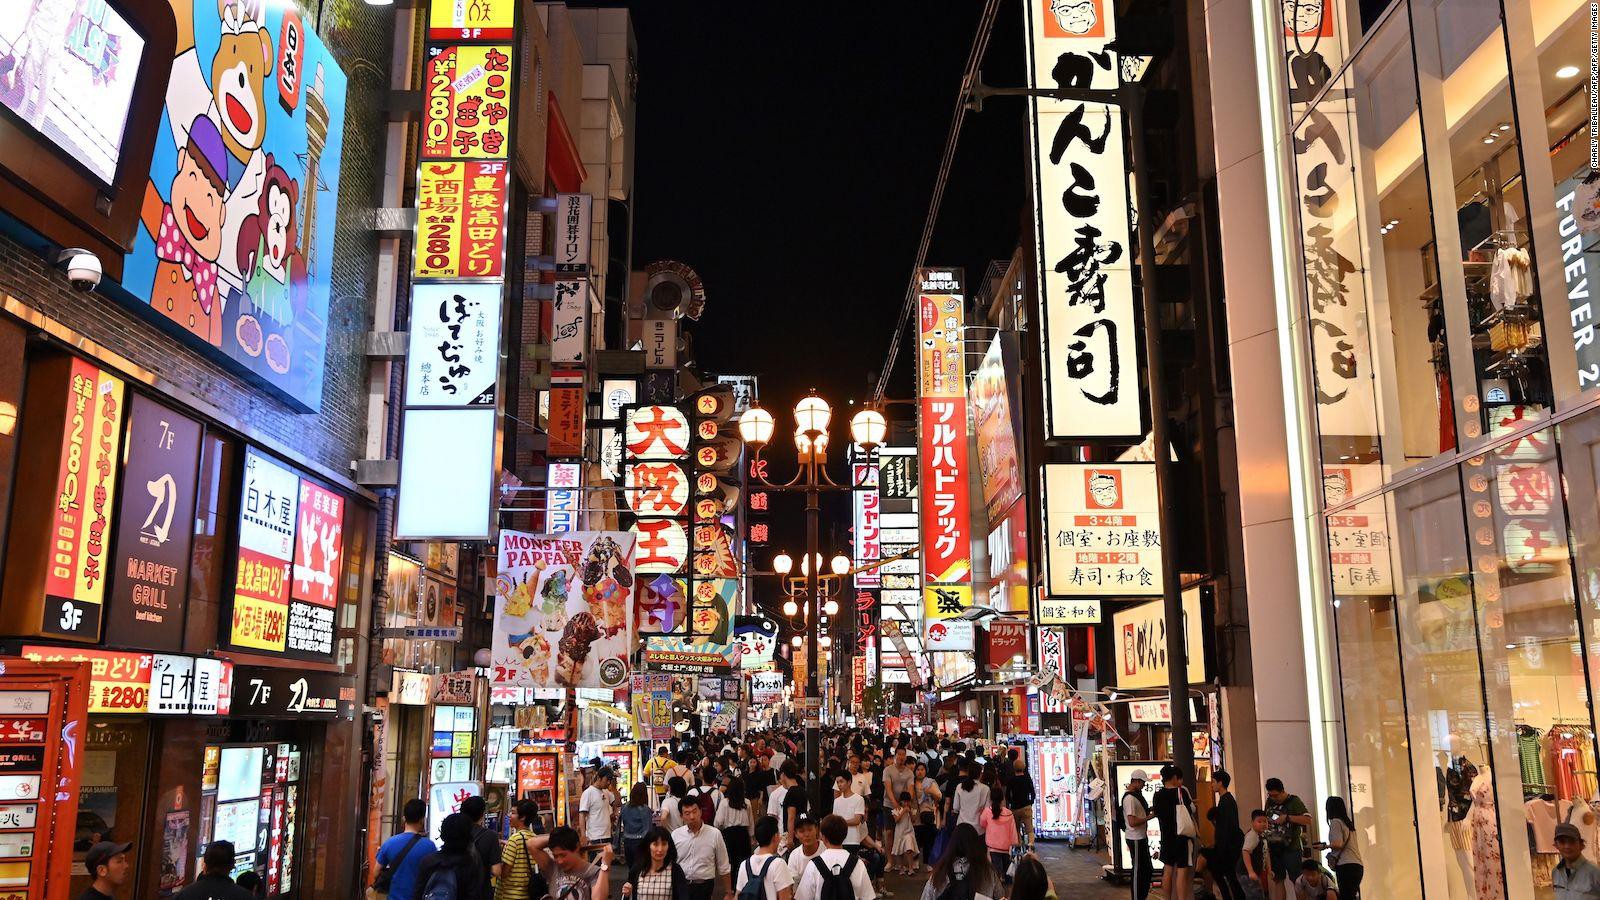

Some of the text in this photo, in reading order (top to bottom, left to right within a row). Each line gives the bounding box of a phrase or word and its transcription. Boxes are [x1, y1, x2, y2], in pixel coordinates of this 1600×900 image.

[461, 28, 481, 38] 3F
[482, 48, 509, 154] たこやき
[479, 164, 504, 174] 2F
[420, 179, 462, 214] 酒場
[467, 176, 501, 276] 豊後高田どり
[567, 196, 580, 263] 浪花囲碁サロン
[1556, 191, 1600, 387] FOREVER 2
[479, 394, 494, 404] 2F
[158, 420, 175, 450] 7F
[626, 405, 690, 568] 大阪王
[931, 402, 961, 560] ツルハドラッグ
[246, 480, 291, 526] 白木屋
[1090, 515, 1123, 526] 3・4階
[504, 535, 583, 551] MONSTER
[1056, 529, 1161, 548] 個室・お座敷
[127, 557, 178, 587] MARKET
[1069, 567, 1153, 586] 寿司・和食
[132, 583, 168, 609] GRILL
[60, 601, 83, 631] 3F
[1042, 605, 1098, 618] 個室・和食
[991, 625, 1025, 636] ツルハ
[161, 664, 209, 700] 白木屋
[494, 666, 517, 682] 2F
[110, 687, 145, 708] 280
[250, 679, 271, 706] 7F
